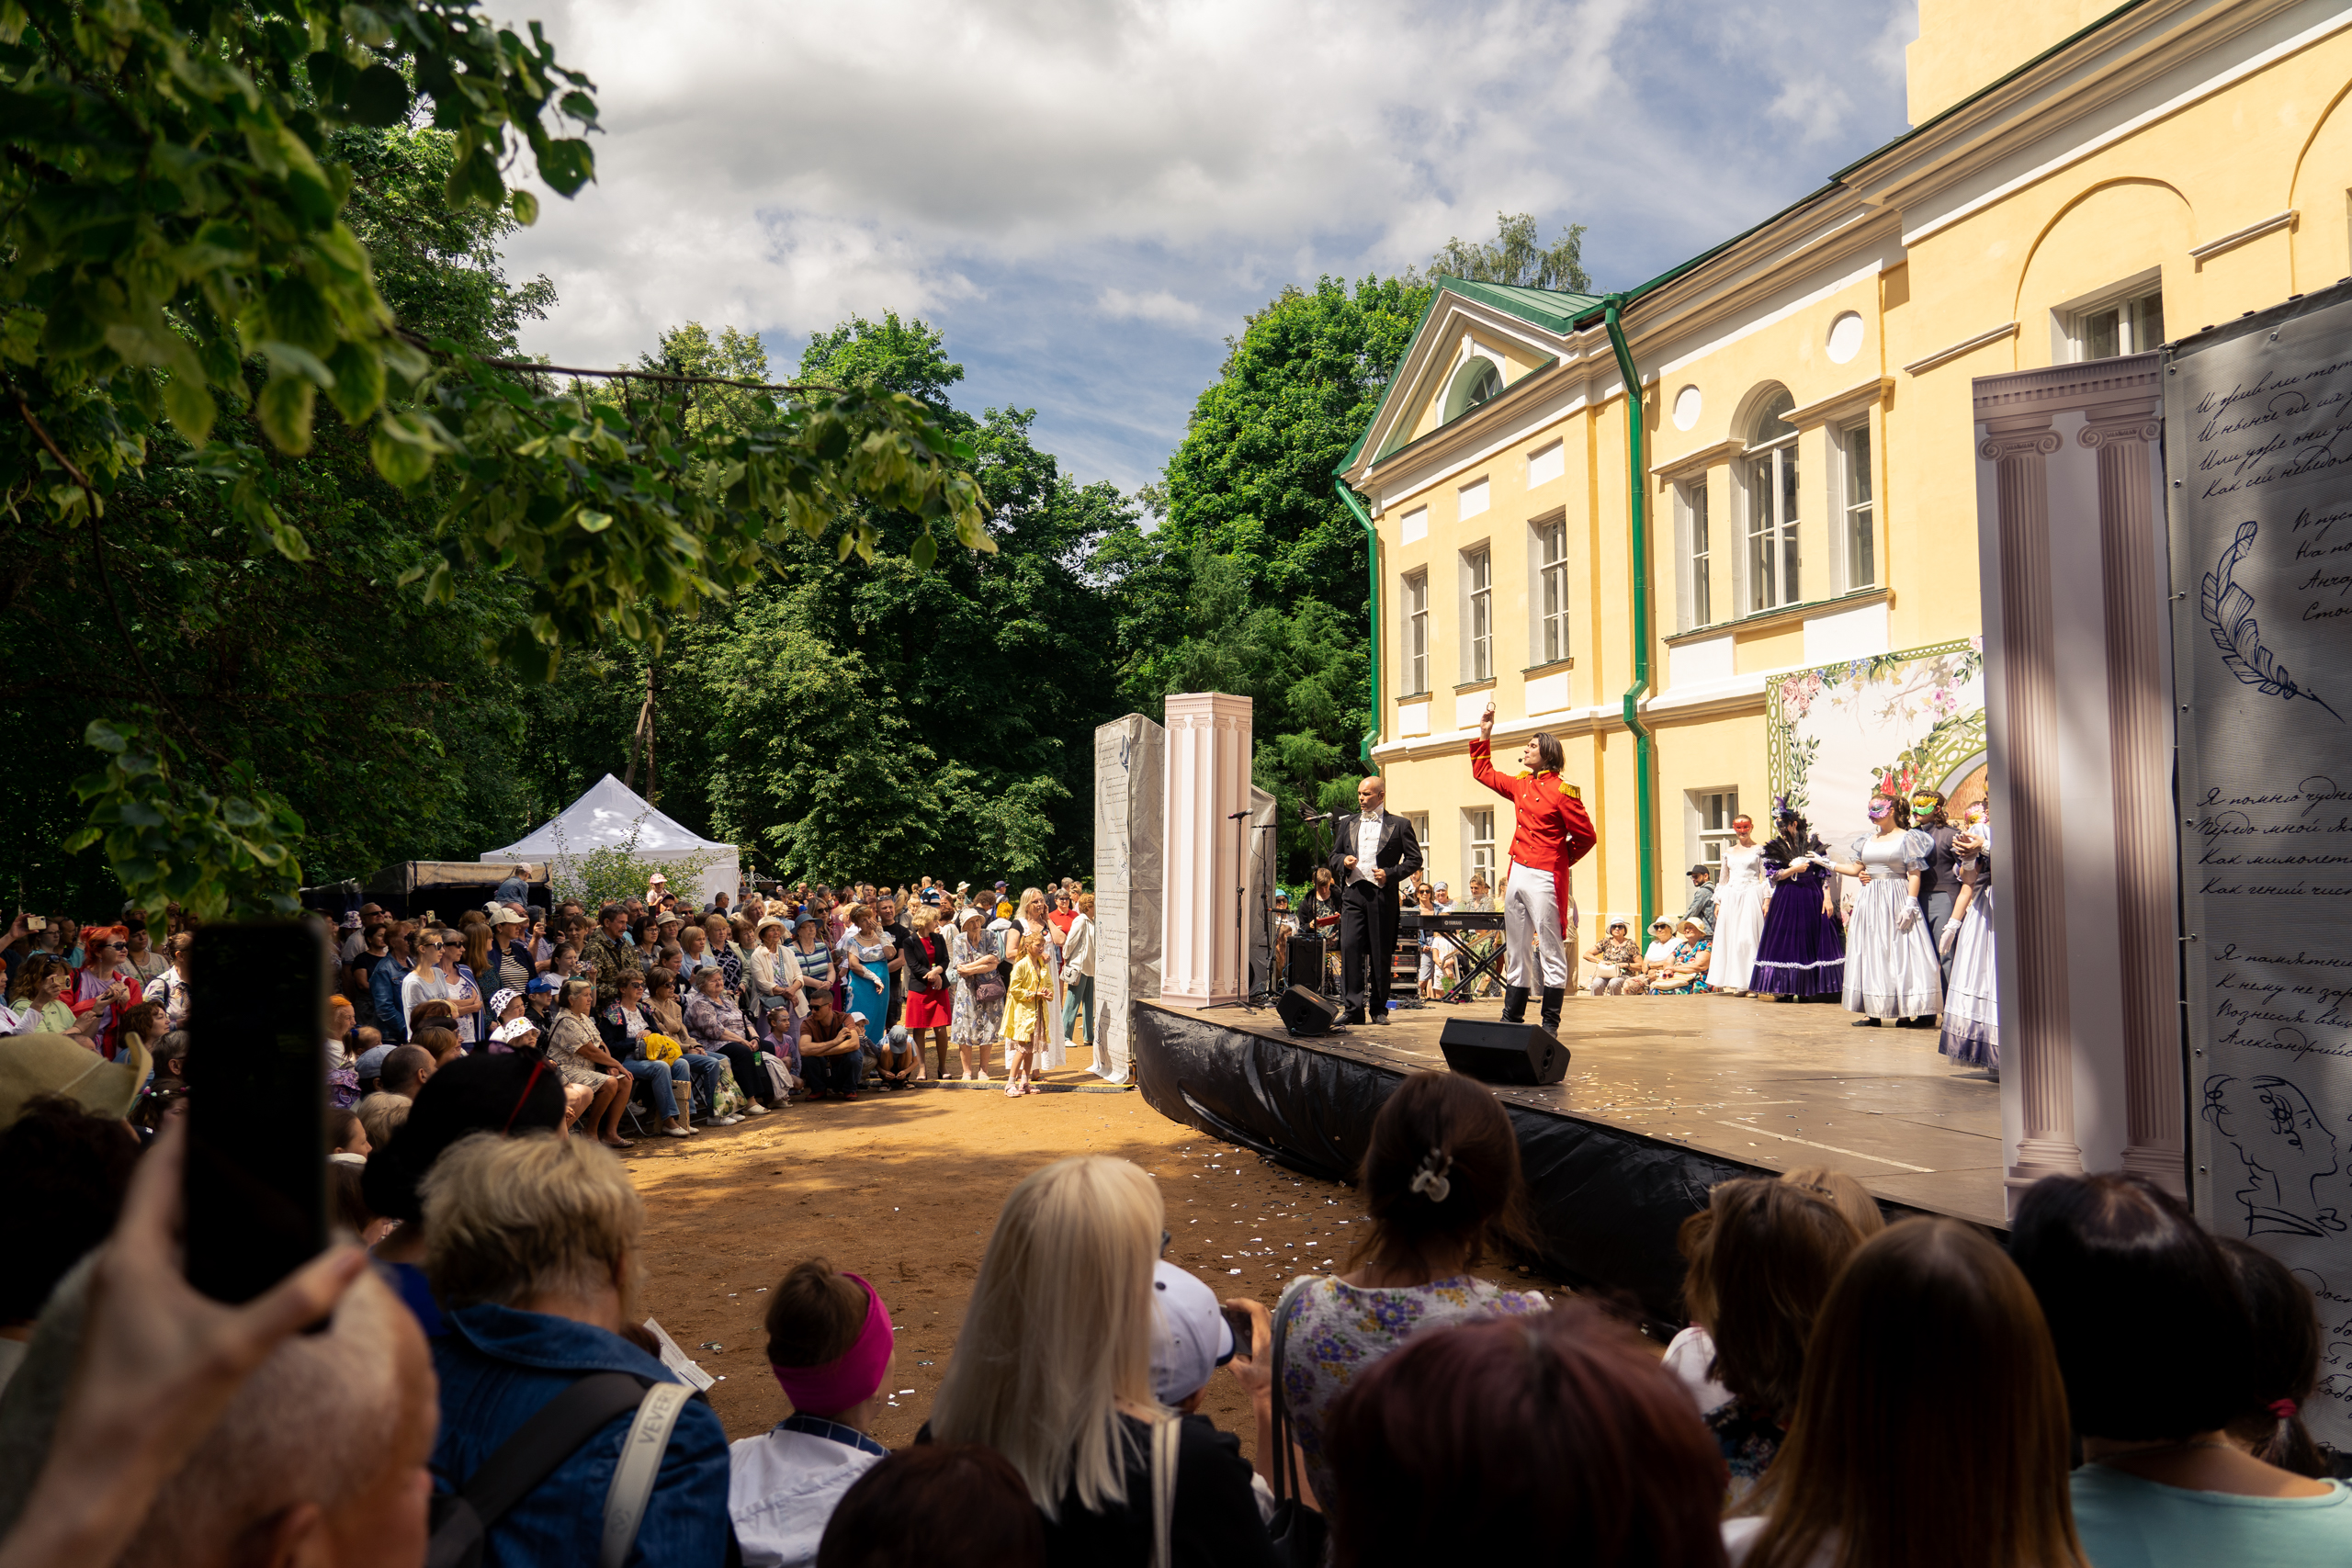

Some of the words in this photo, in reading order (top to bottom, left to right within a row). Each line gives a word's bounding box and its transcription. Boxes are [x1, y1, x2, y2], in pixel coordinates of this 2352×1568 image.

[2196, 392, 2216, 413] И
[2213, 370, 2273, 420] жив
[2270, 378, 2301, 389] ли
[2198, 421, 2218, 442] И
[2221, 412, 2279, 435] нынче
[2317, 392, 2345, 408] их
[2199, 450, 2243, 470] Или
[2234, 434, 2288, 476] уже
[2293, 431, 2331, 446] они
[2202, 478, 2242, 499] Как
[2246, 467, 2275, 487] сей
[2292, 508, 2311, 533] В
[2296, 540, 2326, 560] На
[2197, 787, 2226, 807] Я
[2229, 794, 2301, 805] помню
[2193, 810, 2258, 846] Передо
[2263, 818, 2321, 833] мной
[2198, 847, 2243, 864] Как
[2199, 877, 2243, 894] Как
[2248, 881, 2306, 895] гений
[2214, 943, 2242, 961] Я
[2215, 973, 2235, 987] К
[2238, 981, 2286, 1005] нему
[2291, 985, 2313, 994] не
[2216, 998, 2309, 1026] Вознесся
